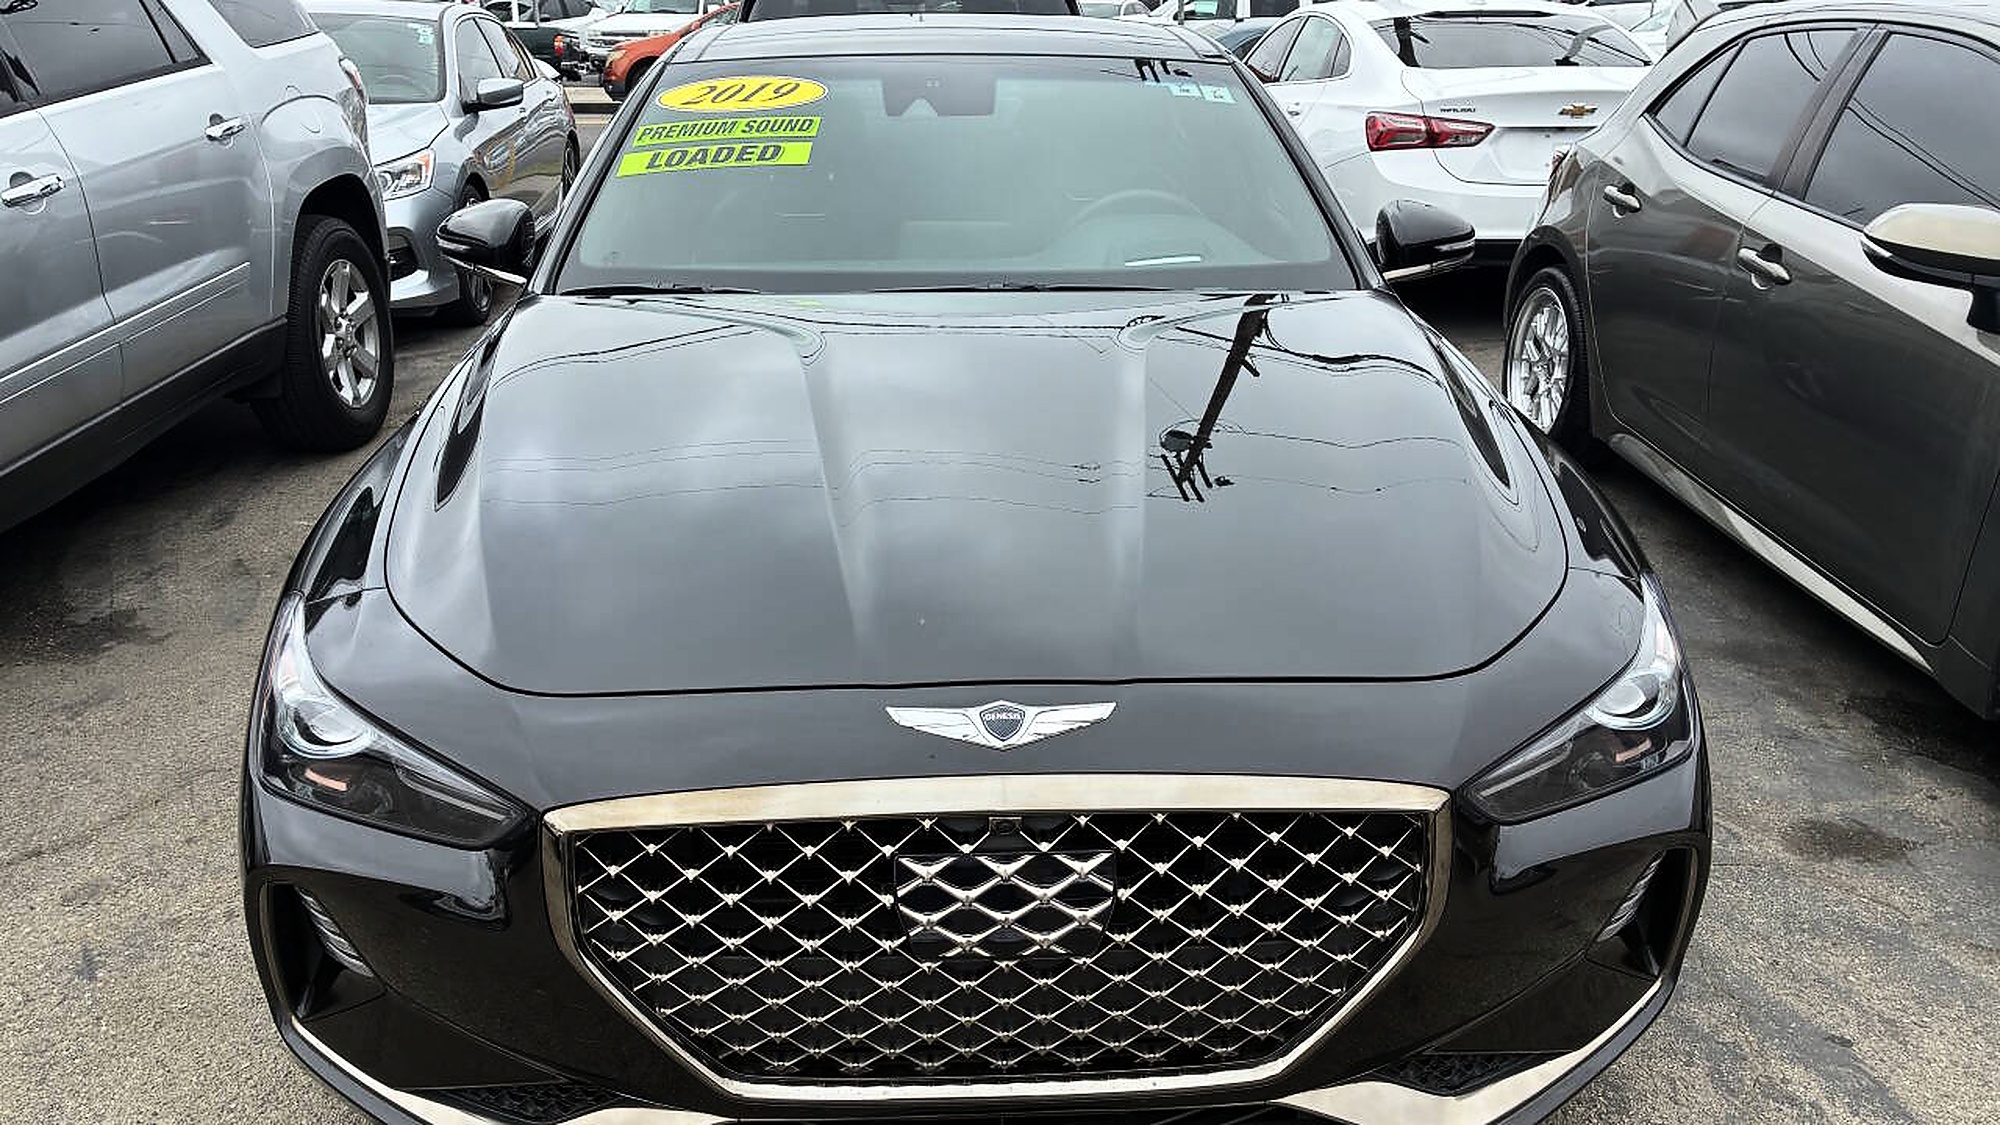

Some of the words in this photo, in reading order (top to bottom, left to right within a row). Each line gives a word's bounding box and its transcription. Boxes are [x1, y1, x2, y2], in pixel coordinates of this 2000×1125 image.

[681, 82, 800, 105] 2019
[637, 120, 737, 141] PREMIUM
[741, 118, 813, 134] SOUND
[645, 144, 783, 169] LOADED
